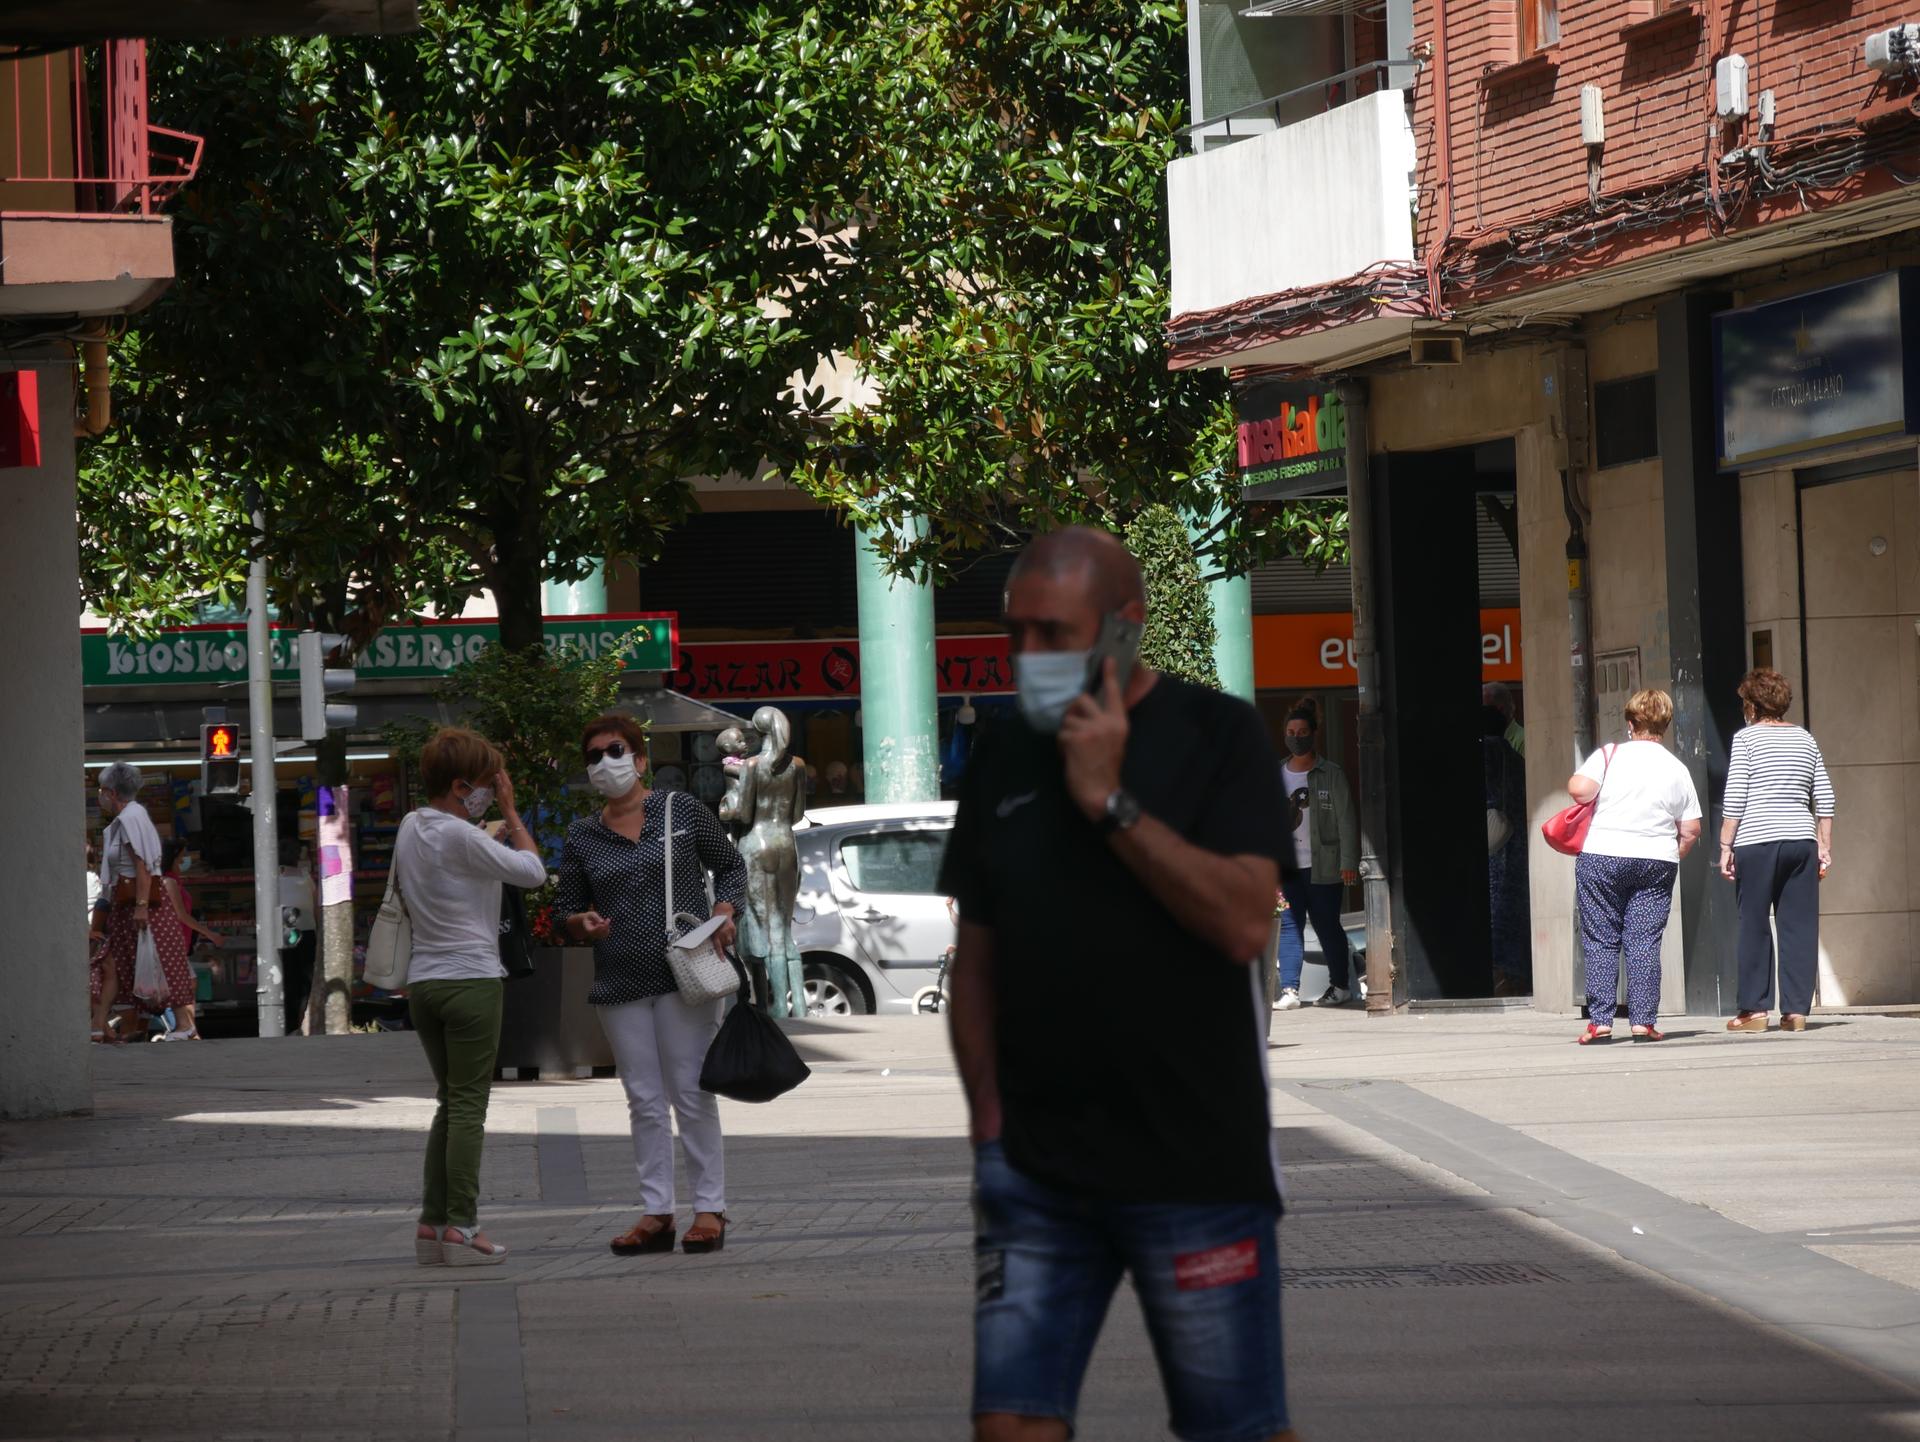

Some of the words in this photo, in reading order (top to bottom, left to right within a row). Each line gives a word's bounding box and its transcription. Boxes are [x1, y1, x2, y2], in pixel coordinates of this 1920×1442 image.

[1243, 468, 1278, 487] PRECIOS
[1280, 460, 1318, 480] FRESCOS
[1319, 455, 1341, 473] PARA
[542, 631, 639, 662] RENSA
[665, 650, 802, 695] BAZAR
